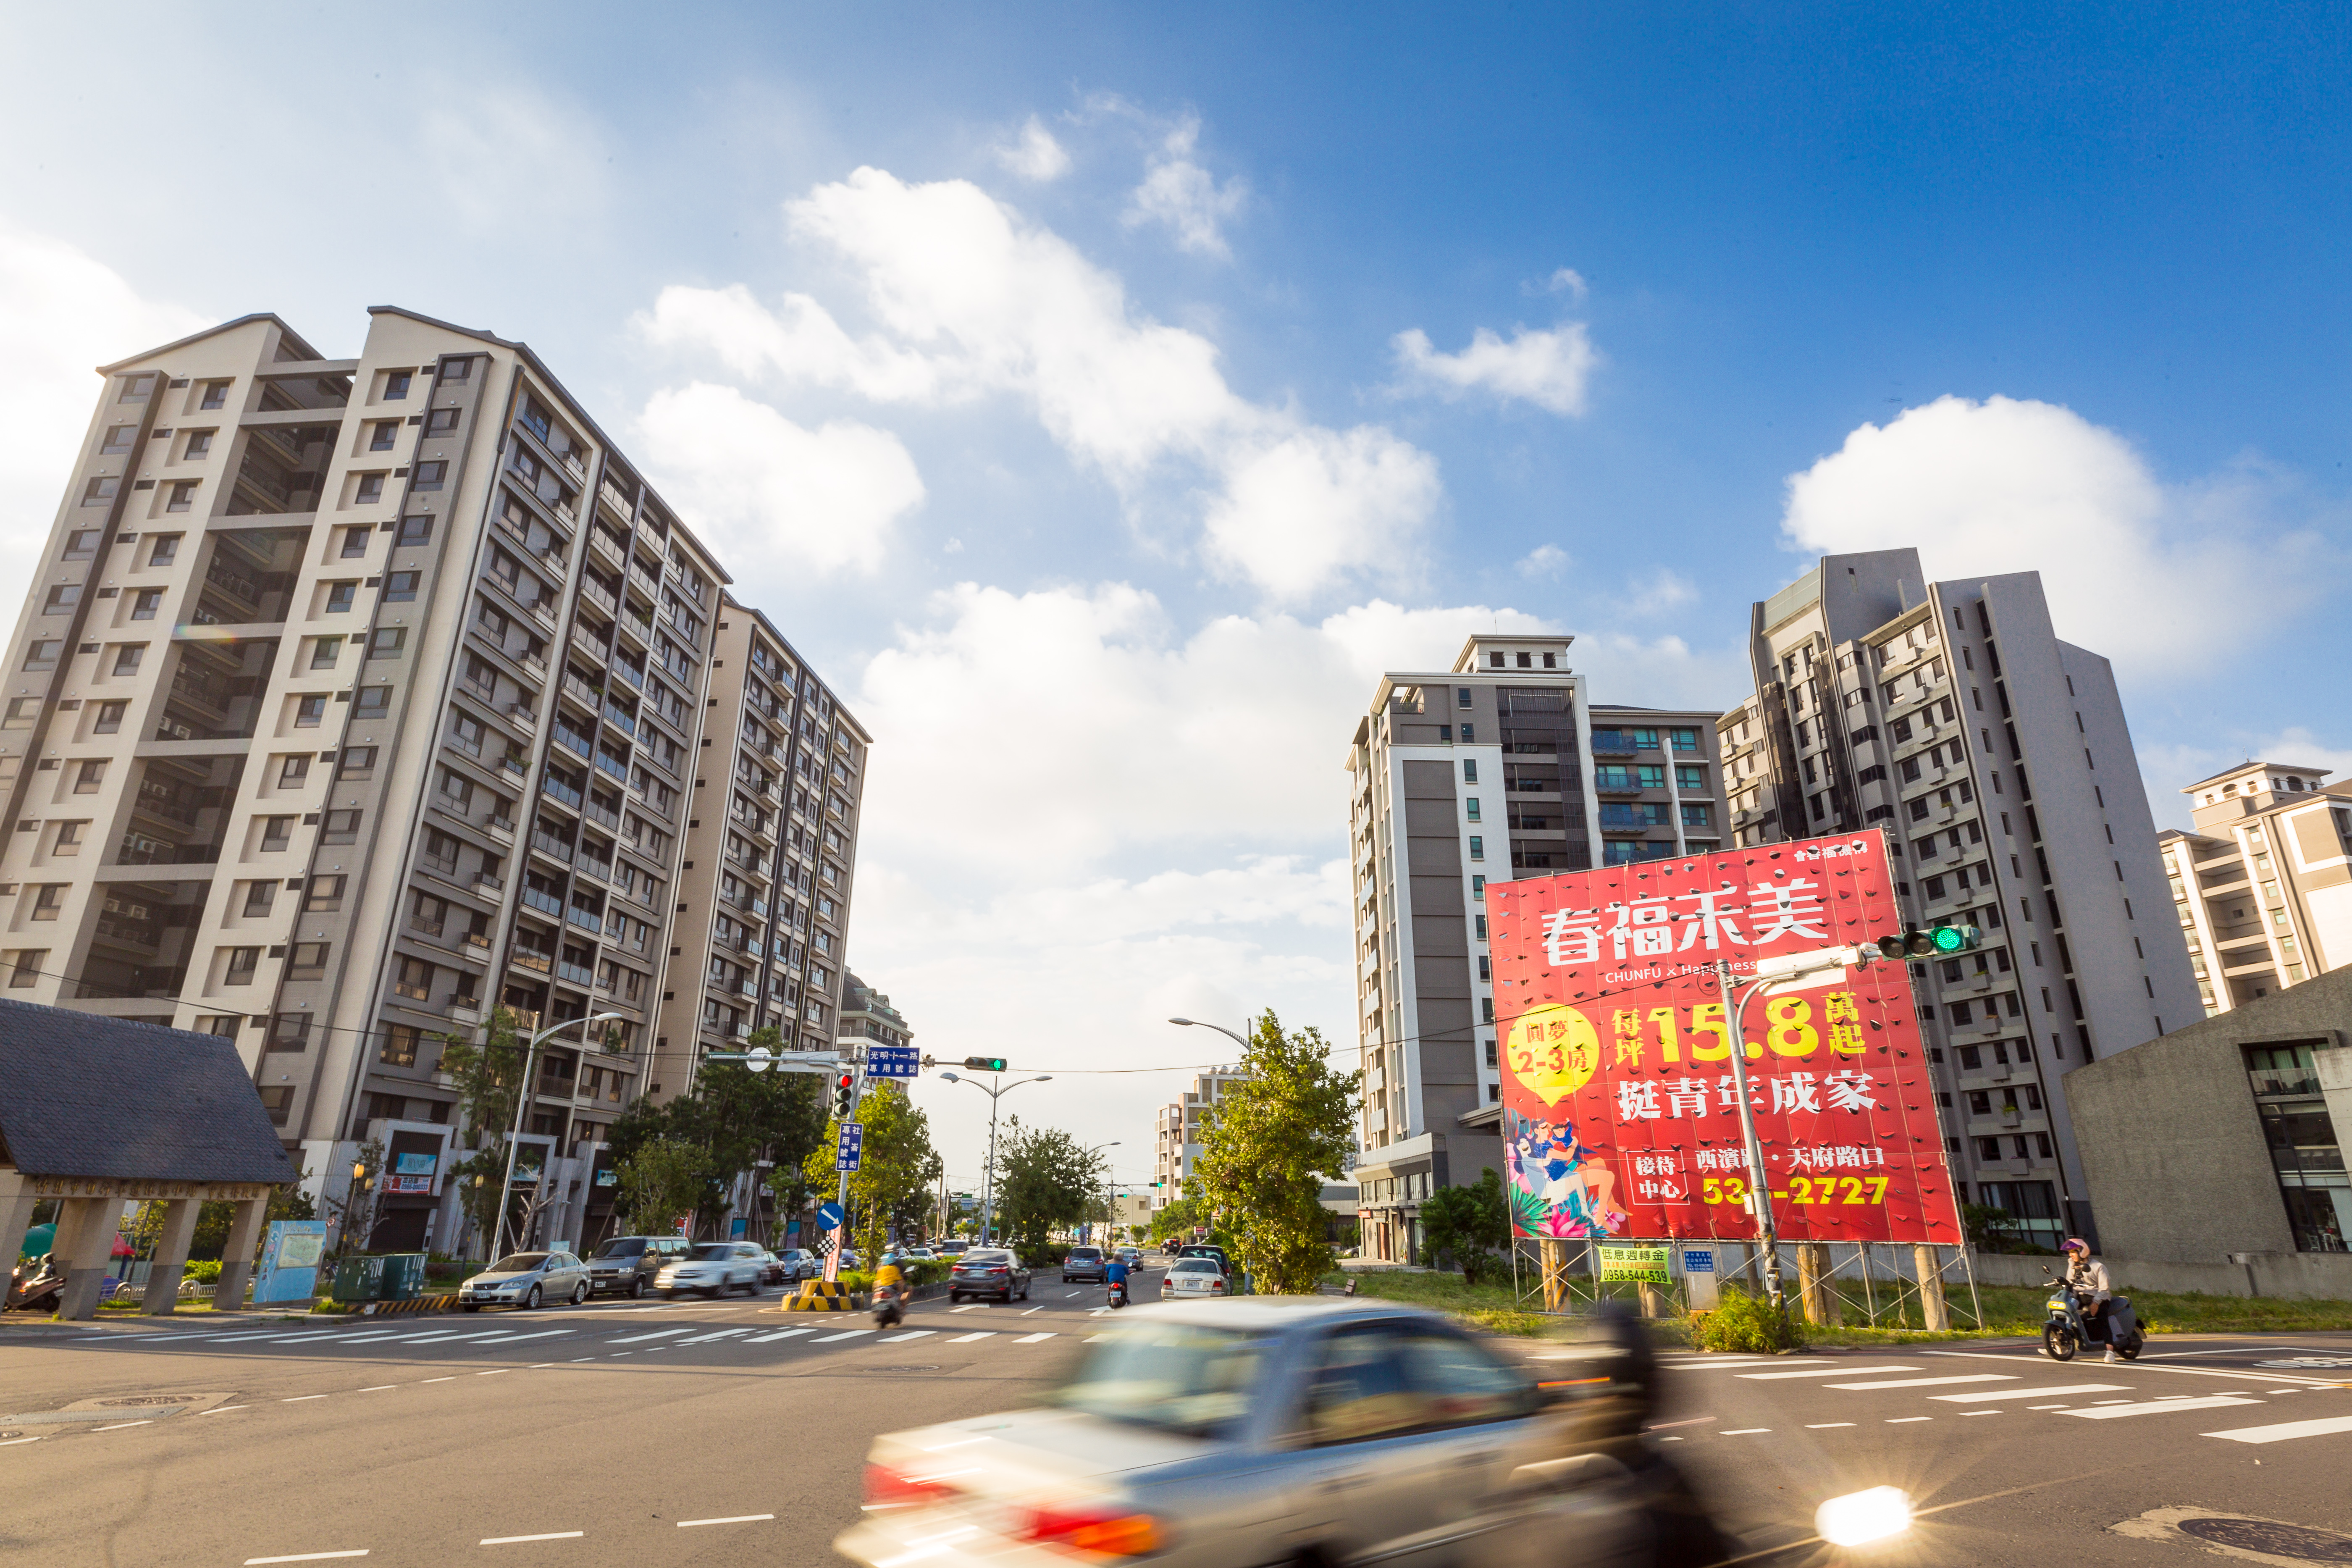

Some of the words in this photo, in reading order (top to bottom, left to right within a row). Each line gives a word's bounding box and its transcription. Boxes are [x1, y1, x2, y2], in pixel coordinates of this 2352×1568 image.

[1542, 877, 1829, 966] 春福禾美
[1605, 968, 1661, 983] CHUNFU
[1682, 961, 1756, 976] Happness
[1526, 1020, 1568, 1043] 圓夢
[1612, 1009, 1645, 1066] 每坪
[1647, 997, 1819, 1062] 15.8
[1822, 992, 1867, 1056] 萬起
[870, 1051, 918, 1060] 光明十一路
[1518, 1049, 1588, 1073] 2-3房
[869, 1064, 917, 1073] 專用號誌
[1618, 1070, 1877, 1121] 挺青年成家
[838, 1125, 850, 1169] 專用號誌
[849, 1126, 860, 1169] 社崙街
[1635, 1156, 1676, 1176] 接待
[1639, 1179, 1680, 1199] 中心
[1703, 1177, 1889, 1205] 53-2727
[1602, 1249, 1664, 1261] 低息週轉金
[1604, 1269, 1667, 1282] 0958-544-539
